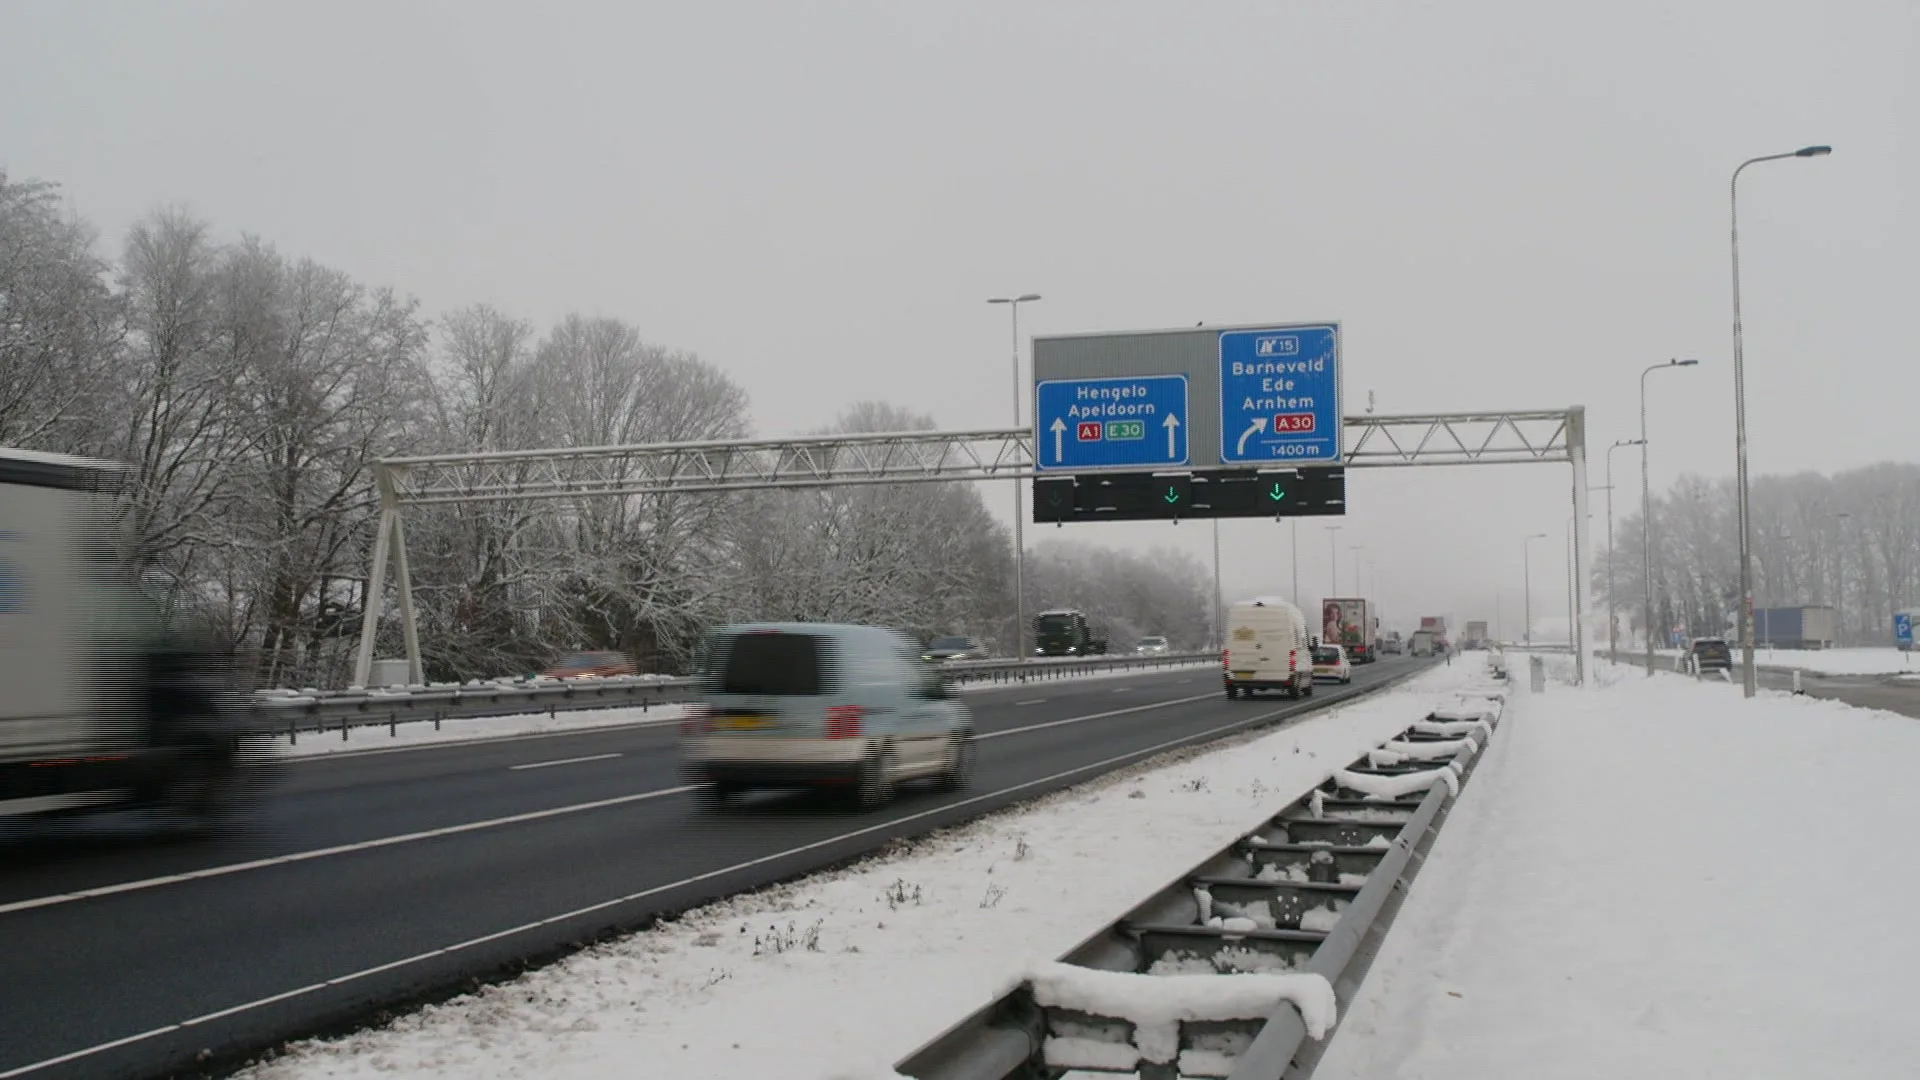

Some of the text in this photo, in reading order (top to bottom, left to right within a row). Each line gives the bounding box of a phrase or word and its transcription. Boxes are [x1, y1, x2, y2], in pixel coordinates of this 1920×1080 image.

[1280, 339, 1294, 351] 15
[1232, 356, 1324, 376] Barneveld
[1077, 383, 1147, 402] Hengelo
[1262, 377, 1295, 393] Ede
[1242, 394, 1314, 410] Arnhem
[1068, 402, 1156, 420] Apeldoorn
[1081, 425, 1099, 438] A1
